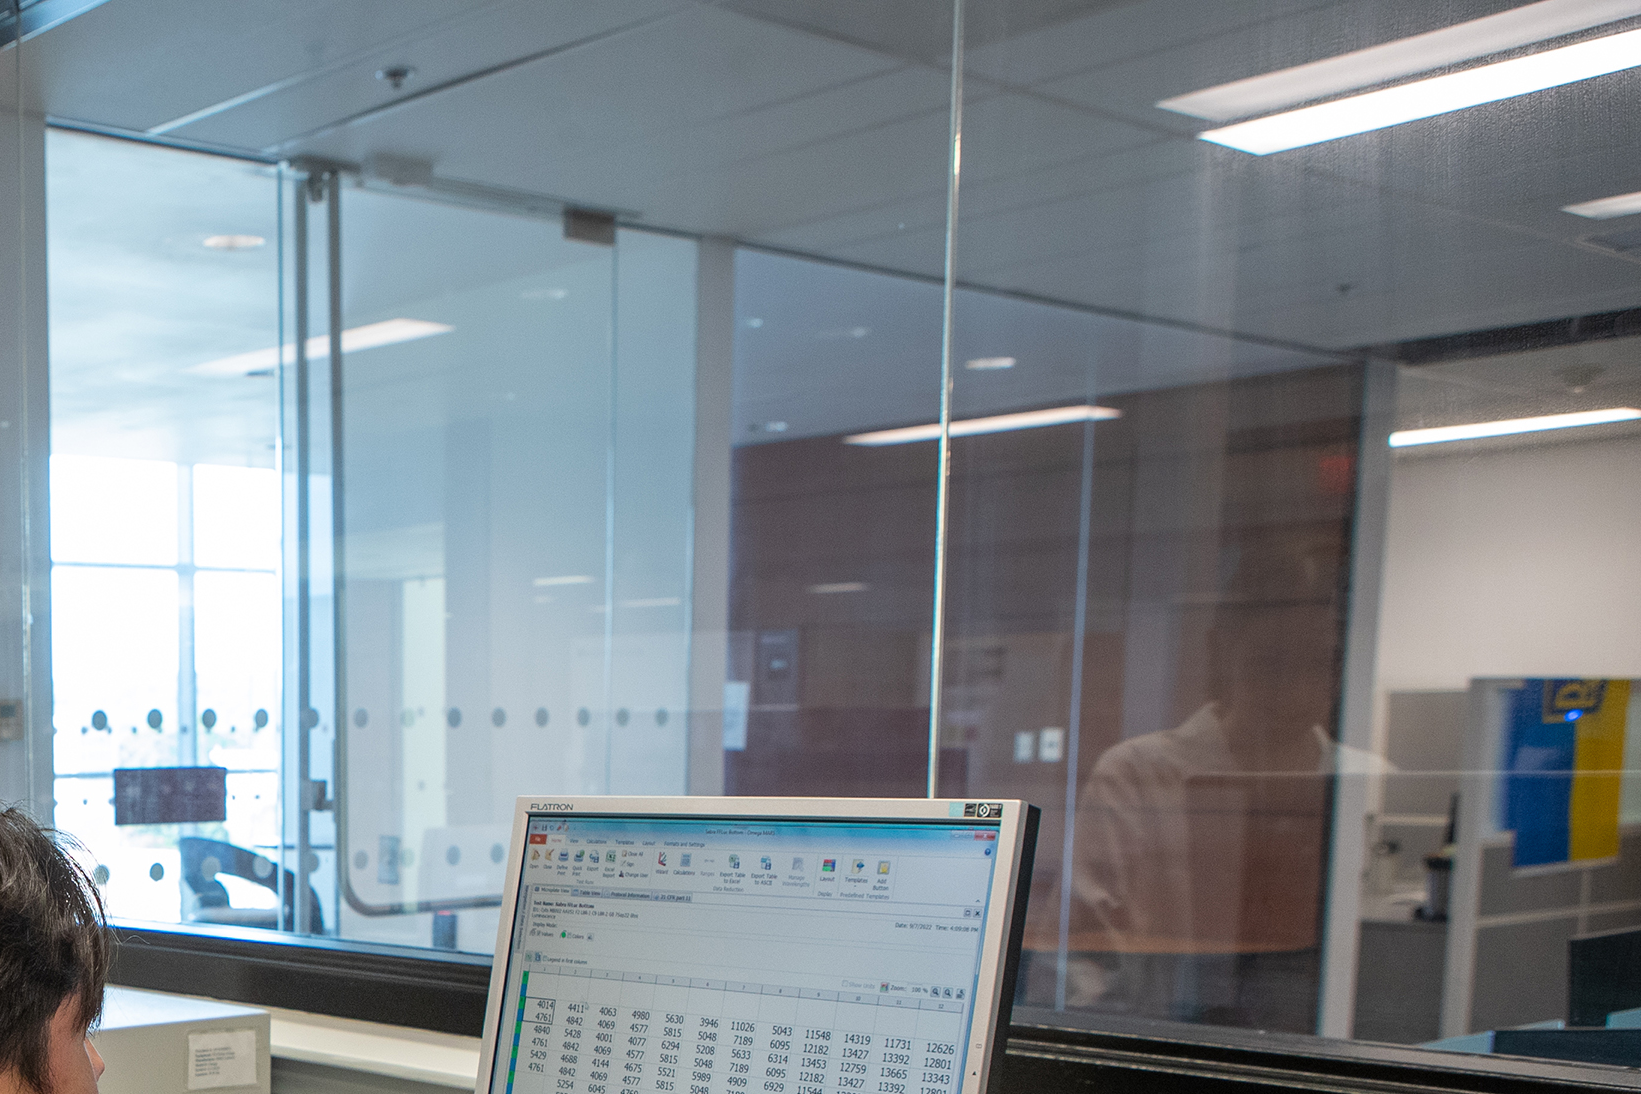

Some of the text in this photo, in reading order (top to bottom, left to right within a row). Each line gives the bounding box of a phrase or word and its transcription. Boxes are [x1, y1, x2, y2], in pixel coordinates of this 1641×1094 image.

[533, 1025, 950, 1085] 4840 5428 4001 4077 6294 5208 5633 6314 13453 12759 13665 13343
[536, 1012, 951, 1070] 4761 4842 4069 4577 5815 5048 7189 6095 12182 13427 13392 12801
[537, 1000, 954, 1055] 4014 4411 4063 4980 5630 3946 11026 5043 11548 14319 11731 12626
[528, 1062, 544, 1072] 4761
[558, 1067, 576, 1077] 4842
[589, 1071, 608, 1081] 4069
[622, 1076, 641, 1086] 4577
[655, 1080, 674, 1091] 5815
[530, 1050, 547, 1060] 5429
[560, 1054, 578, 1064] 4688
[591, 1058, 609, 1068] 4144
[624, 1062, 642, 1073] 4675
[657, 1066, 675, 1078] 5521
[692, 1071, 711, 1082] 5989
[727, 1076, 747, 1088] 4909
[763, 1081, 784, 1092] 6929
[531, 1038, 548, 1047] 4761
[562, 1042, 579, 1052] 4842
[593, 1046, 612, 1056] 4069
[626, 1050, 644, 1060] 4577
[659, 1053, 678, 1064] 5815
[694, 1058, 713, 1069] 5048
[729, 1062, 749, 1074] 7189
[765, 1067, 786, 1078] 6095
[799, 1072, 825, 1084] 12182
[838, 1076, 865, 1088] 13427
[878, 1082, 905, 1094] 13392
[557, 1079, 574, 1089] 5254
[587, 1084, 606, 1094] 6045
